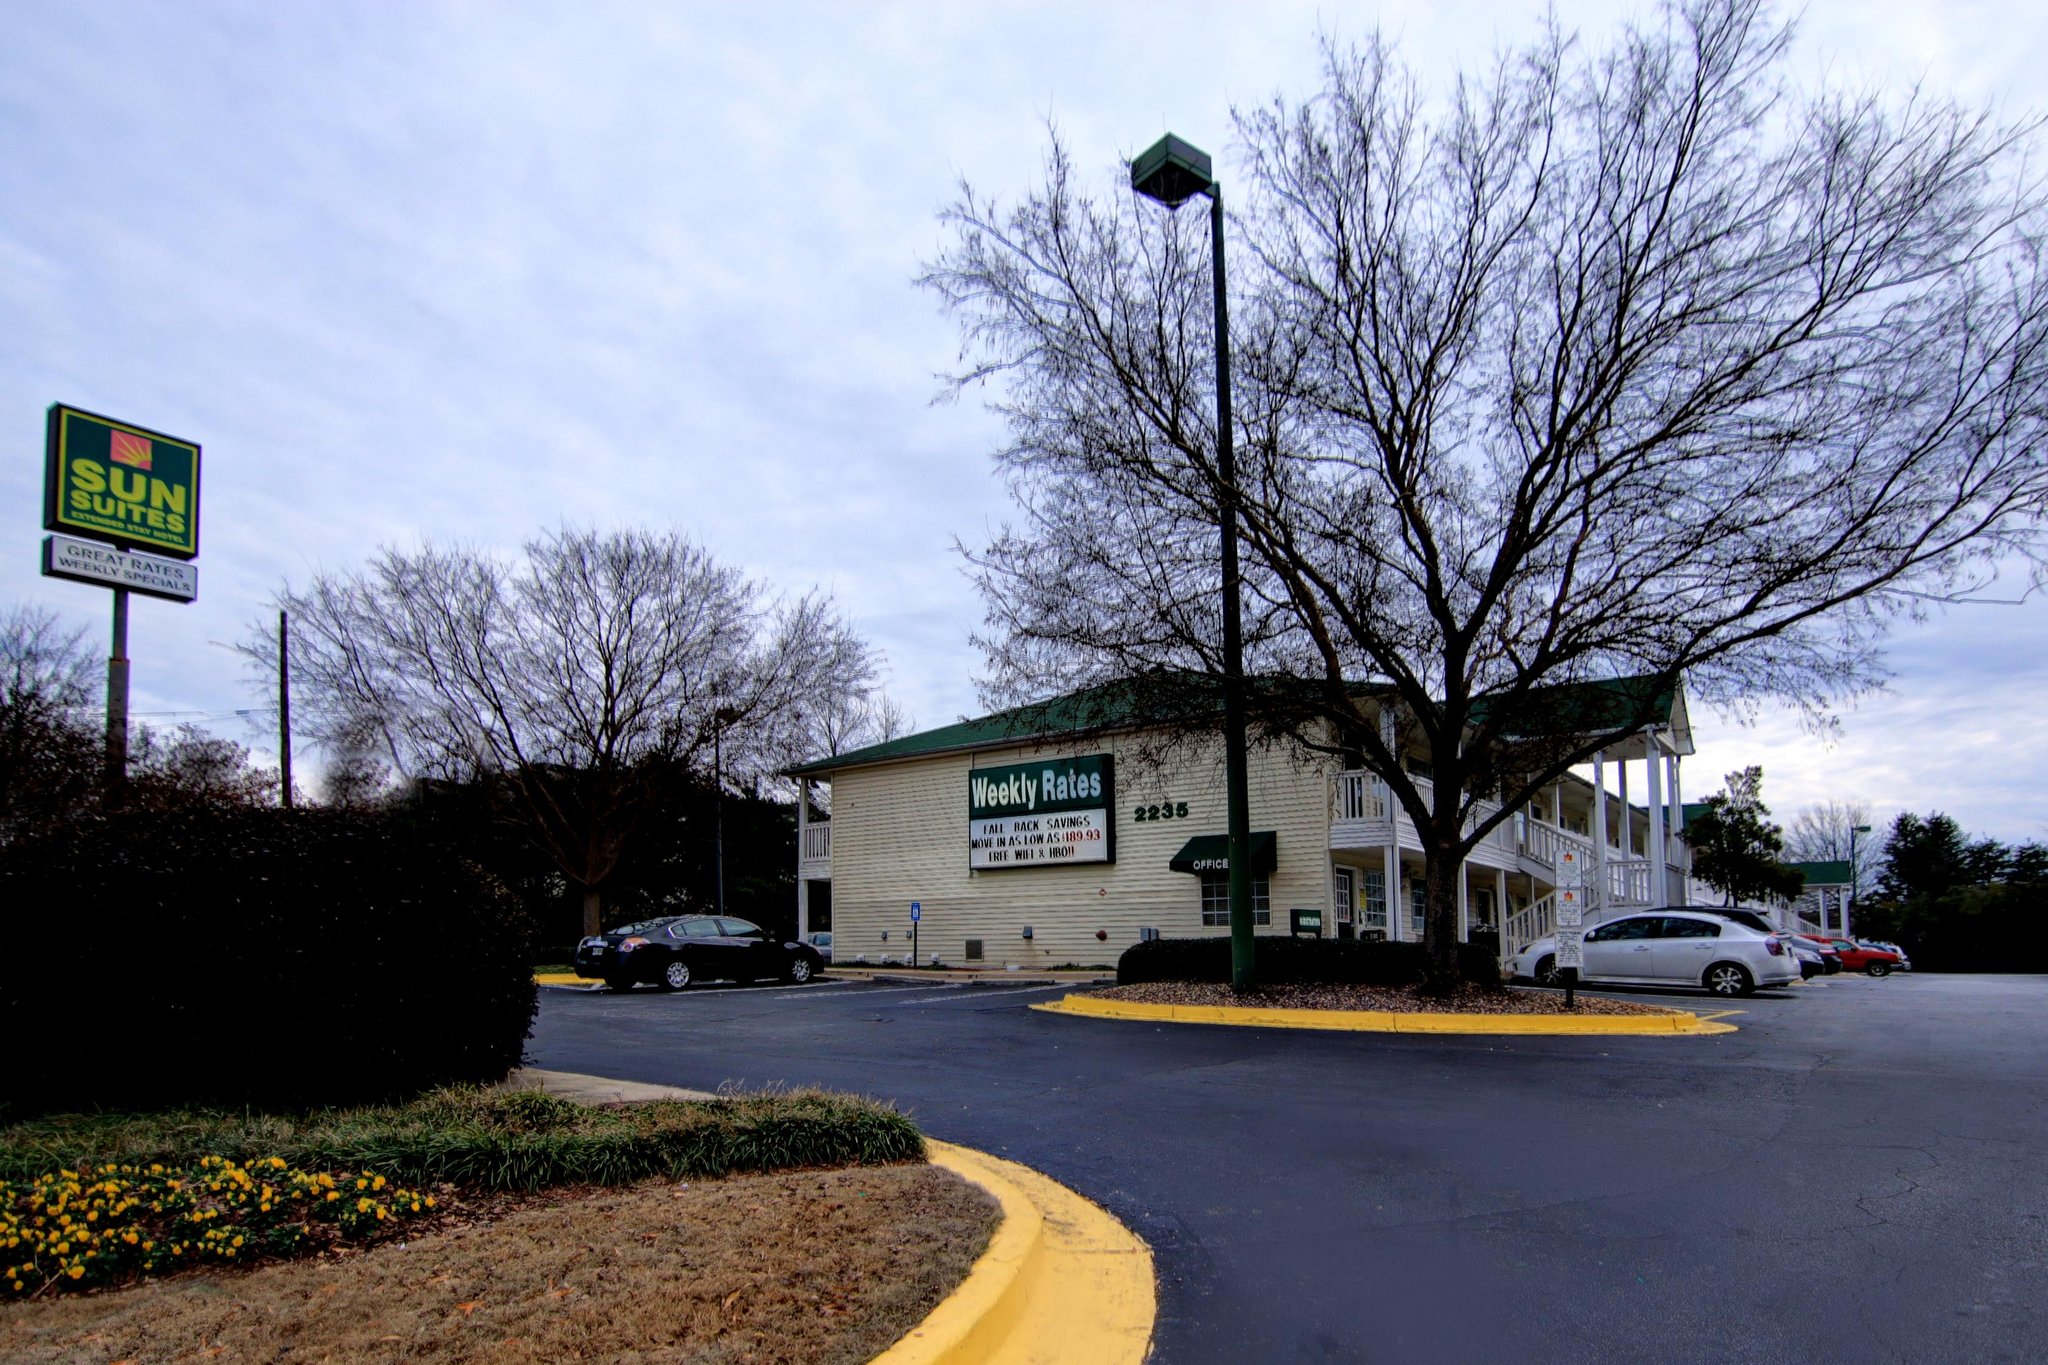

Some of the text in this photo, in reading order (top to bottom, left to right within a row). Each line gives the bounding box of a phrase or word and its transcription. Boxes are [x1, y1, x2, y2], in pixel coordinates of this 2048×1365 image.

[71, 458, 186, 515] SUN
[70, 489, 186, 533] SUITES
[127, 523, 151, 535] STAY
[153, 530, 185, 544] HOTEL
[67, 544, 184, 579] GREAT RATES
[58, 556, 191, 592] WEEKLY SPECIALS
[971, 768, 1102, 811] Weekly Rates
[1134, 802, 1189, 822] 2235
[983, 814, 1091, 835] FALL BACK SAVINGS
[971, 838, 993, 850] MOVE
[997, 836, 1006, 848] IN
[1008, 834, 1022, 847] AS
[1024, 832, 1044, 846] LOW
[1046, 831, 1060, 844] AS
[988, 851, 1009, 863] FREE
[1014, 848, 1034, 861] WIFI
[1038, 849, 1045, 859] &
[1193, 858, 1230, 871] OFFICE
